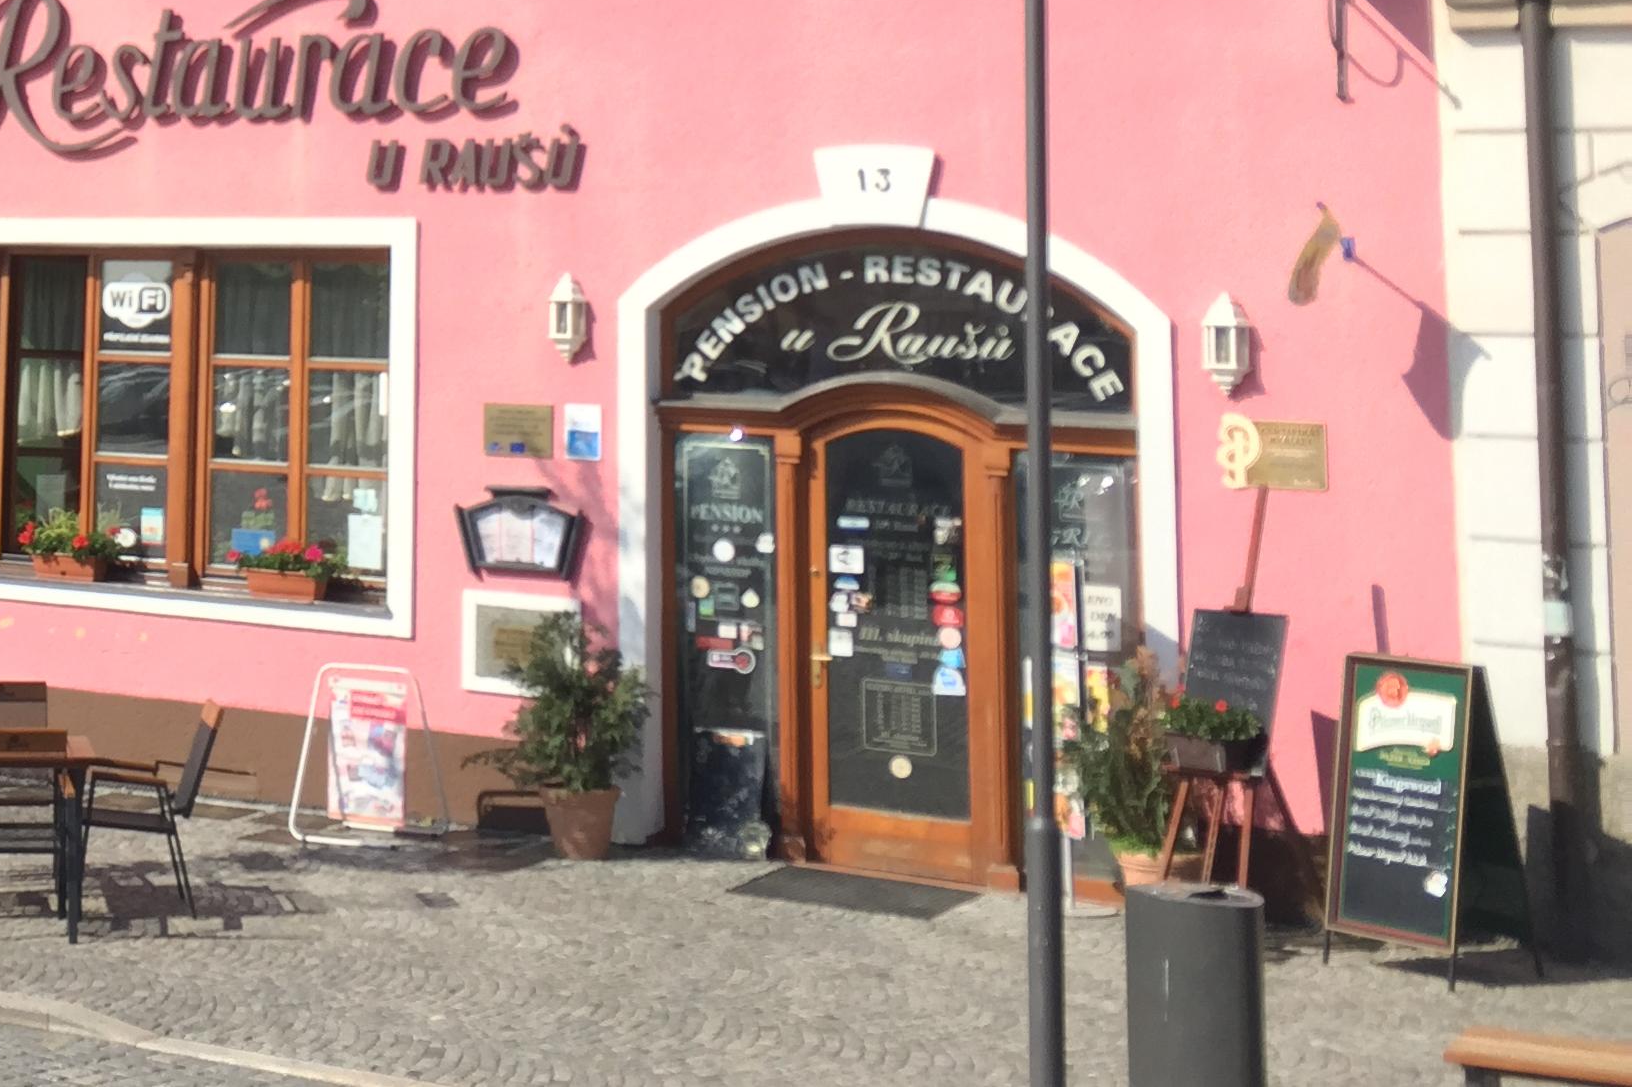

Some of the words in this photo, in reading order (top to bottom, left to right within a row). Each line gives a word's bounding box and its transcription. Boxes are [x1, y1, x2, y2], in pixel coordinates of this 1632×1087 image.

[367, 140, 406, 192] U
[857, 169, 892, 193] 13
[674, 261, 829, 383] PENSION
[864, 255, 1125, 403] RESTAUACE
[690, 503, 764, 524] PENSION
